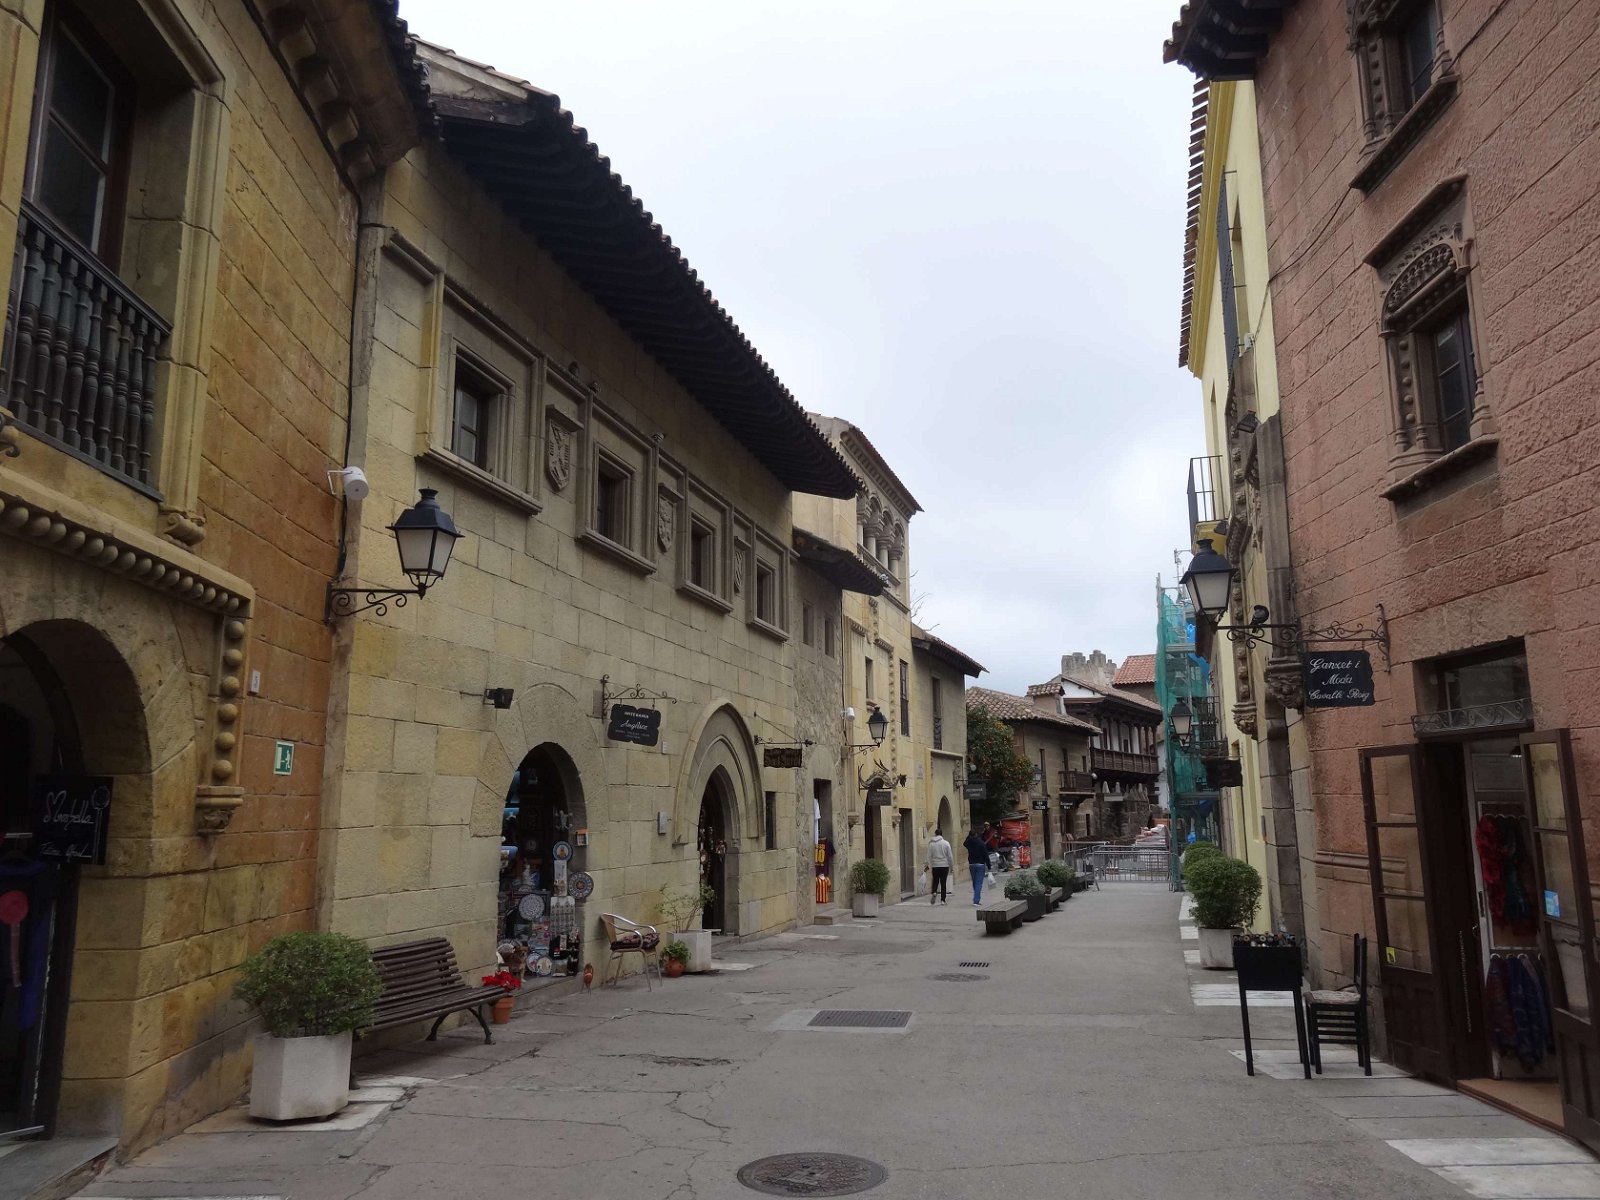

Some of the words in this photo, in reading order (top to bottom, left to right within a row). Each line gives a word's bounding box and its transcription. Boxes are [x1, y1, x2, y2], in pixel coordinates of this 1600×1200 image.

[1309, 658, 1353, 674] Ganxet
[1354, 660, 1361, 669] i
[1321, 673, 1353, 685] Moda
